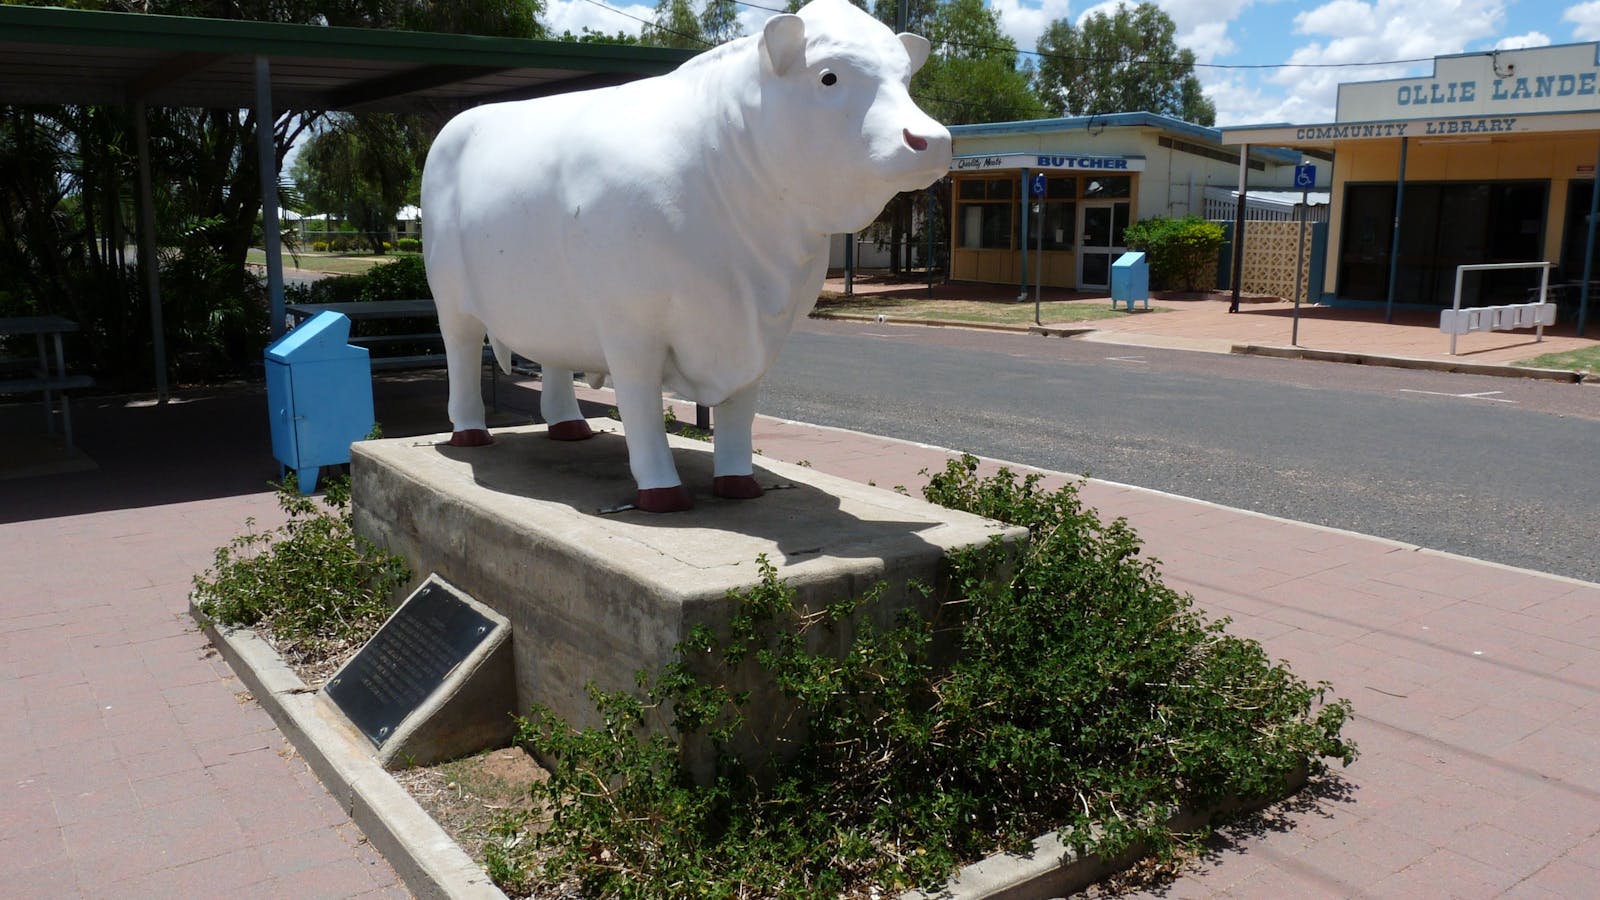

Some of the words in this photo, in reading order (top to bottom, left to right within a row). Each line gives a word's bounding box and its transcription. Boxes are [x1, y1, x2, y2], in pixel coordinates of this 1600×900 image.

[1397, 81, 1476, 106] OLLIE
[1492, 73, 1600, 101] LANDE
[1297, 123, 1408, 140] COMMUNITY
[1425, 118, 1517, 134] LIBRARY
[958, 158, 981, 170] Quality
[982, 157, 1002, 168] Meats
[1037, 156, 1128, 170] BUTCHER
